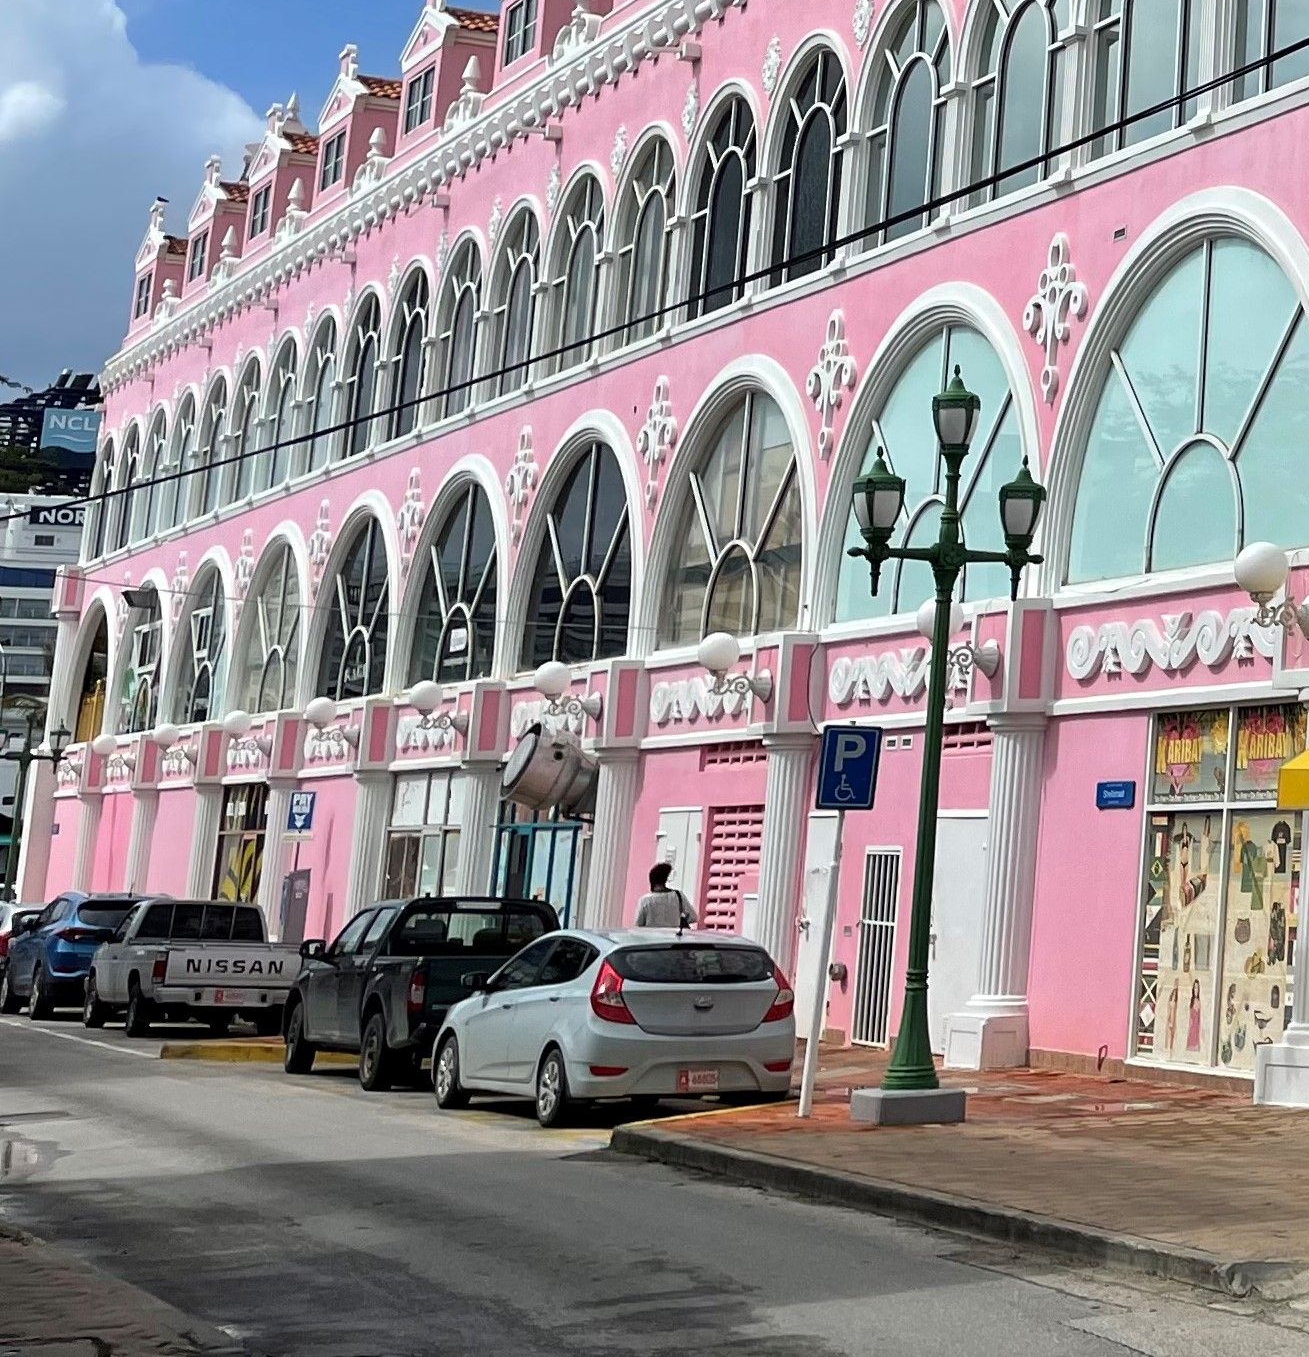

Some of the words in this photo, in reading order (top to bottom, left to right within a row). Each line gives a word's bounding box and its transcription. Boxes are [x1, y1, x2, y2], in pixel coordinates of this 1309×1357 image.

[49, 415, 96, 431] NCL
[834, 734, 866, 772] P
[186, 958, 284, 974] NISSAN
